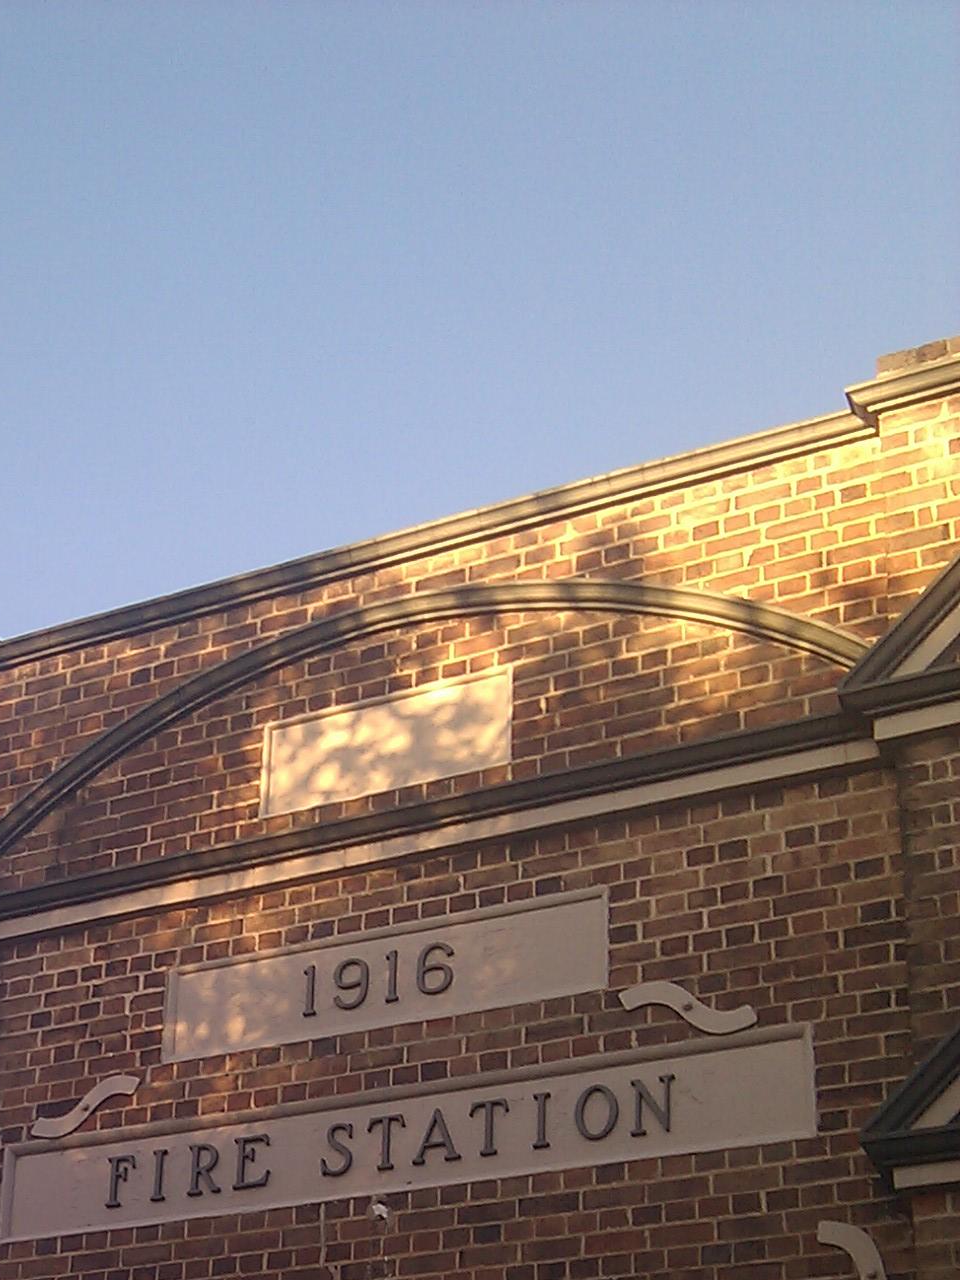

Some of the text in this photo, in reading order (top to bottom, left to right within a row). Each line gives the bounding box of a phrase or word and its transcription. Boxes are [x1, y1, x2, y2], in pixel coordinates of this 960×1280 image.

[302, 941, 456, 1018] 1916
[105, 1072, 676, 1208] FIRE STATION
